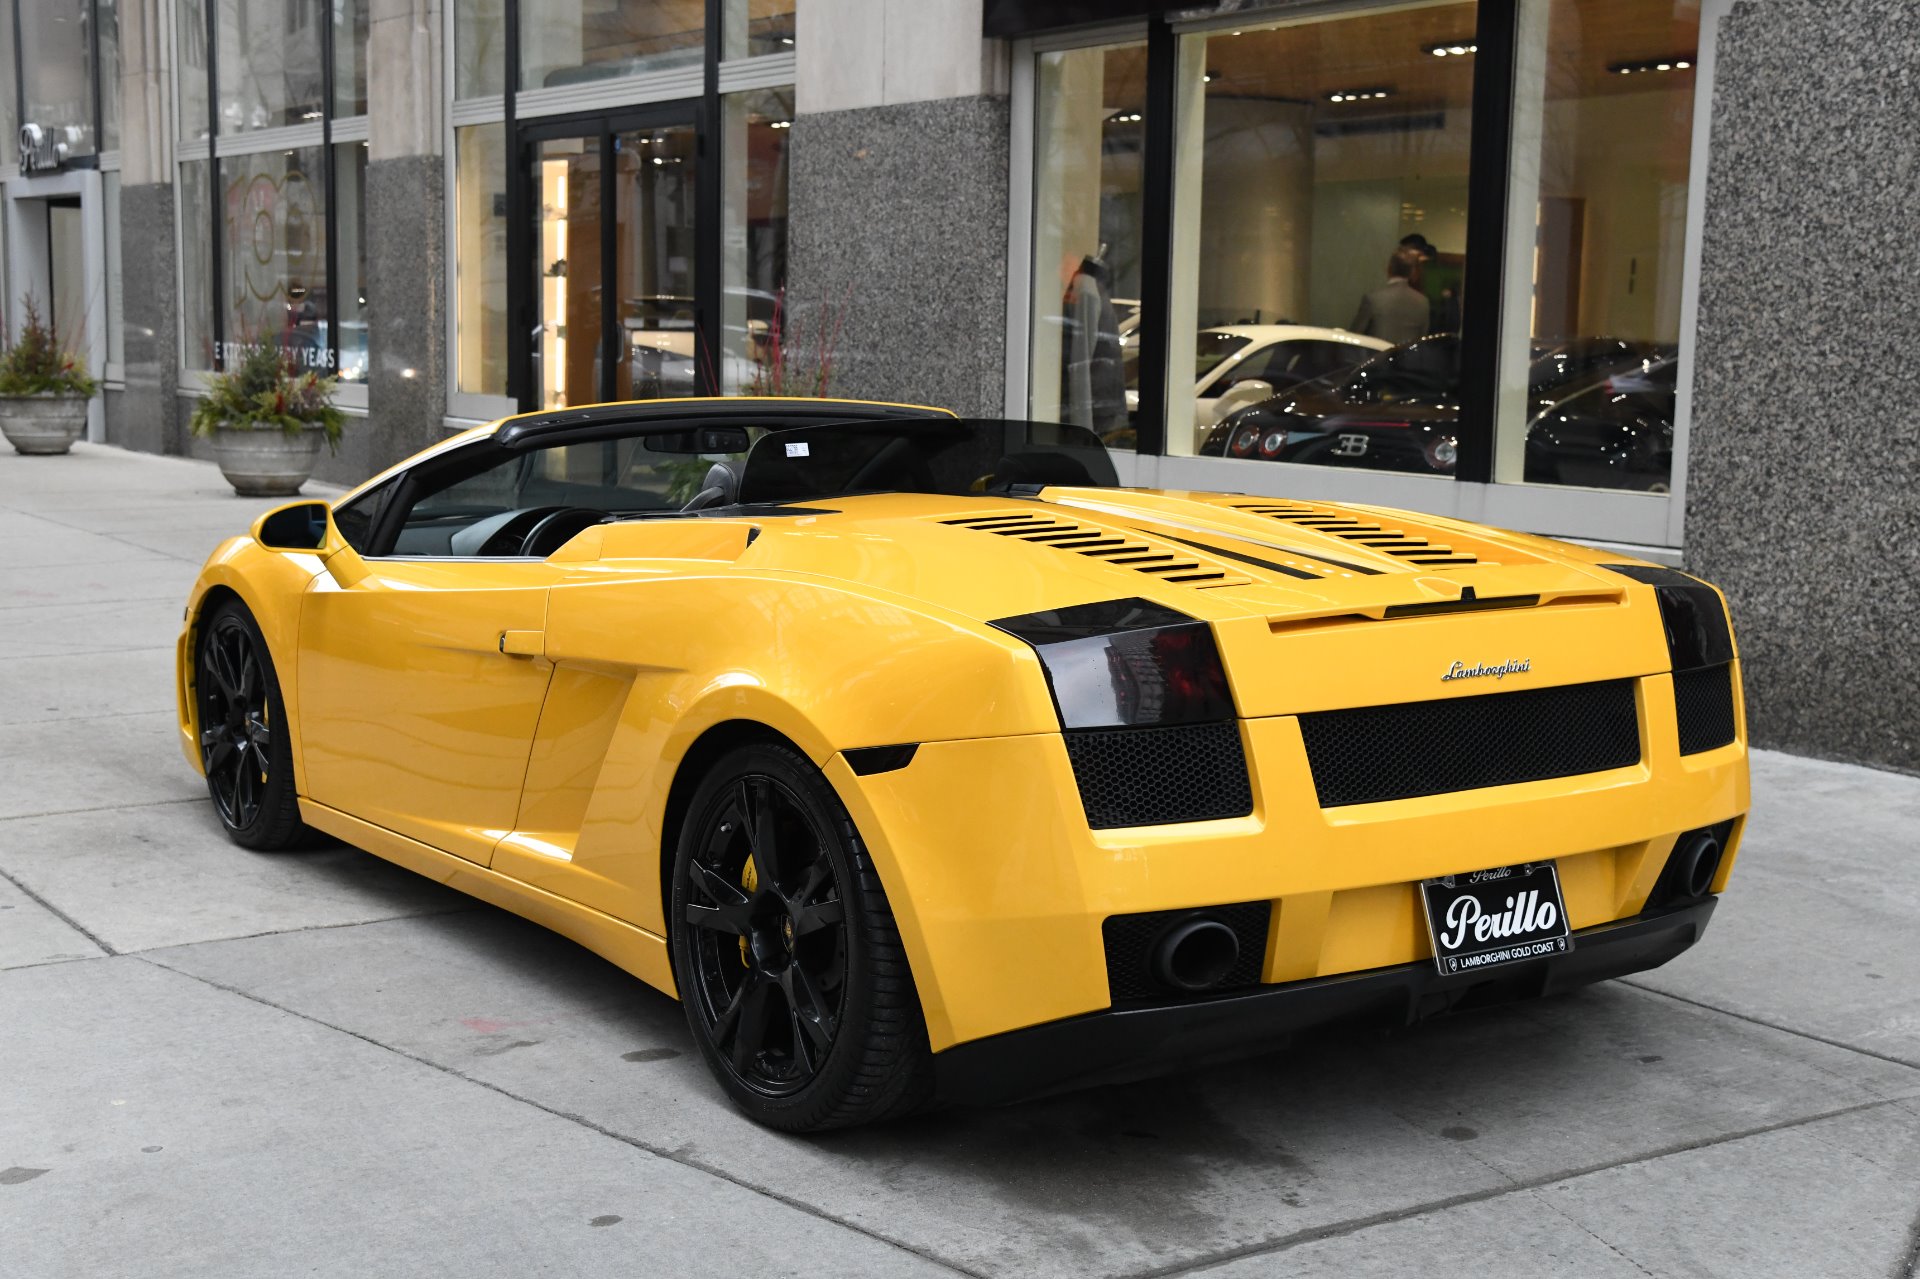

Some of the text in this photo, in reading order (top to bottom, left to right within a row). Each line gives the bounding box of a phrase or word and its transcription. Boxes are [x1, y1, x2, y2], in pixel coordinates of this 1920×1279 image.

[1441, 659, 1530, 681] Lamborghini
[1469, 866, 1512, 884] Perillo
[1440, 889, 1557, 950] Perillo
[1460, 941, 1554, 968] LAMBORGHINI GOLD COAST
